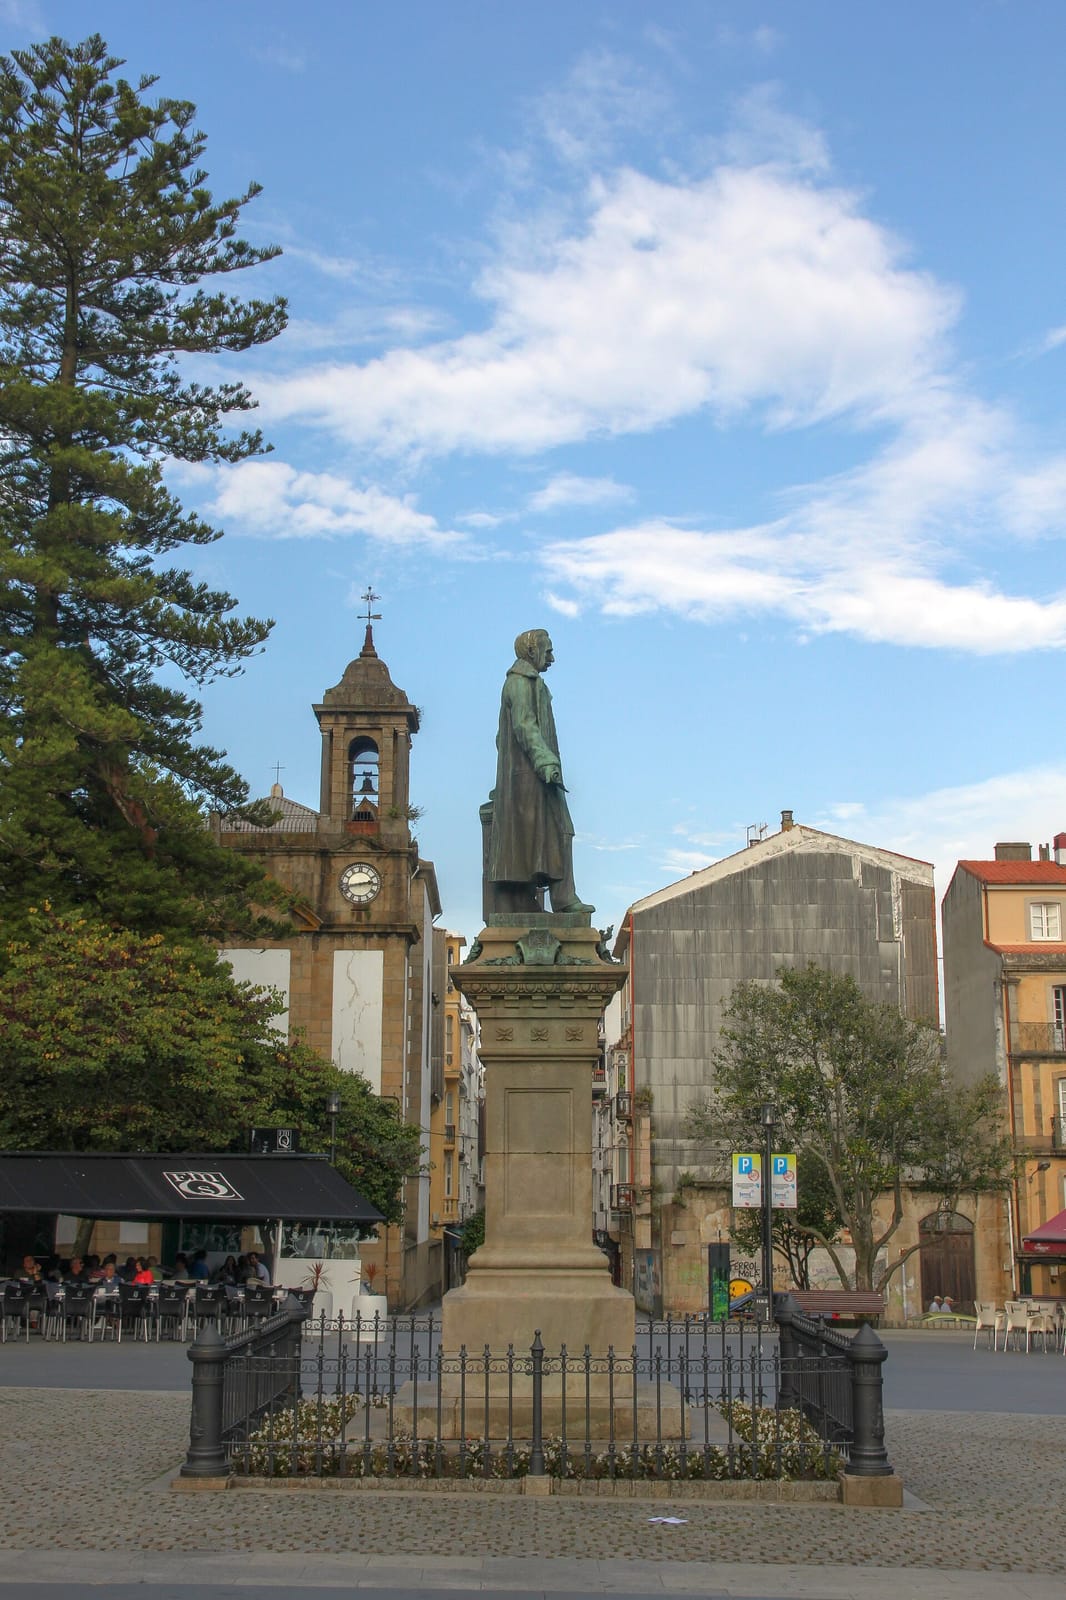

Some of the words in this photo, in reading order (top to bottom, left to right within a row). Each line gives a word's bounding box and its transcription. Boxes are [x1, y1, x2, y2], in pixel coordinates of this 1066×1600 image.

[742, 1158, 750, 1172] P
[777, 1158, 785, 1173] P
[730, 1260, 760, 1271] FERROL
